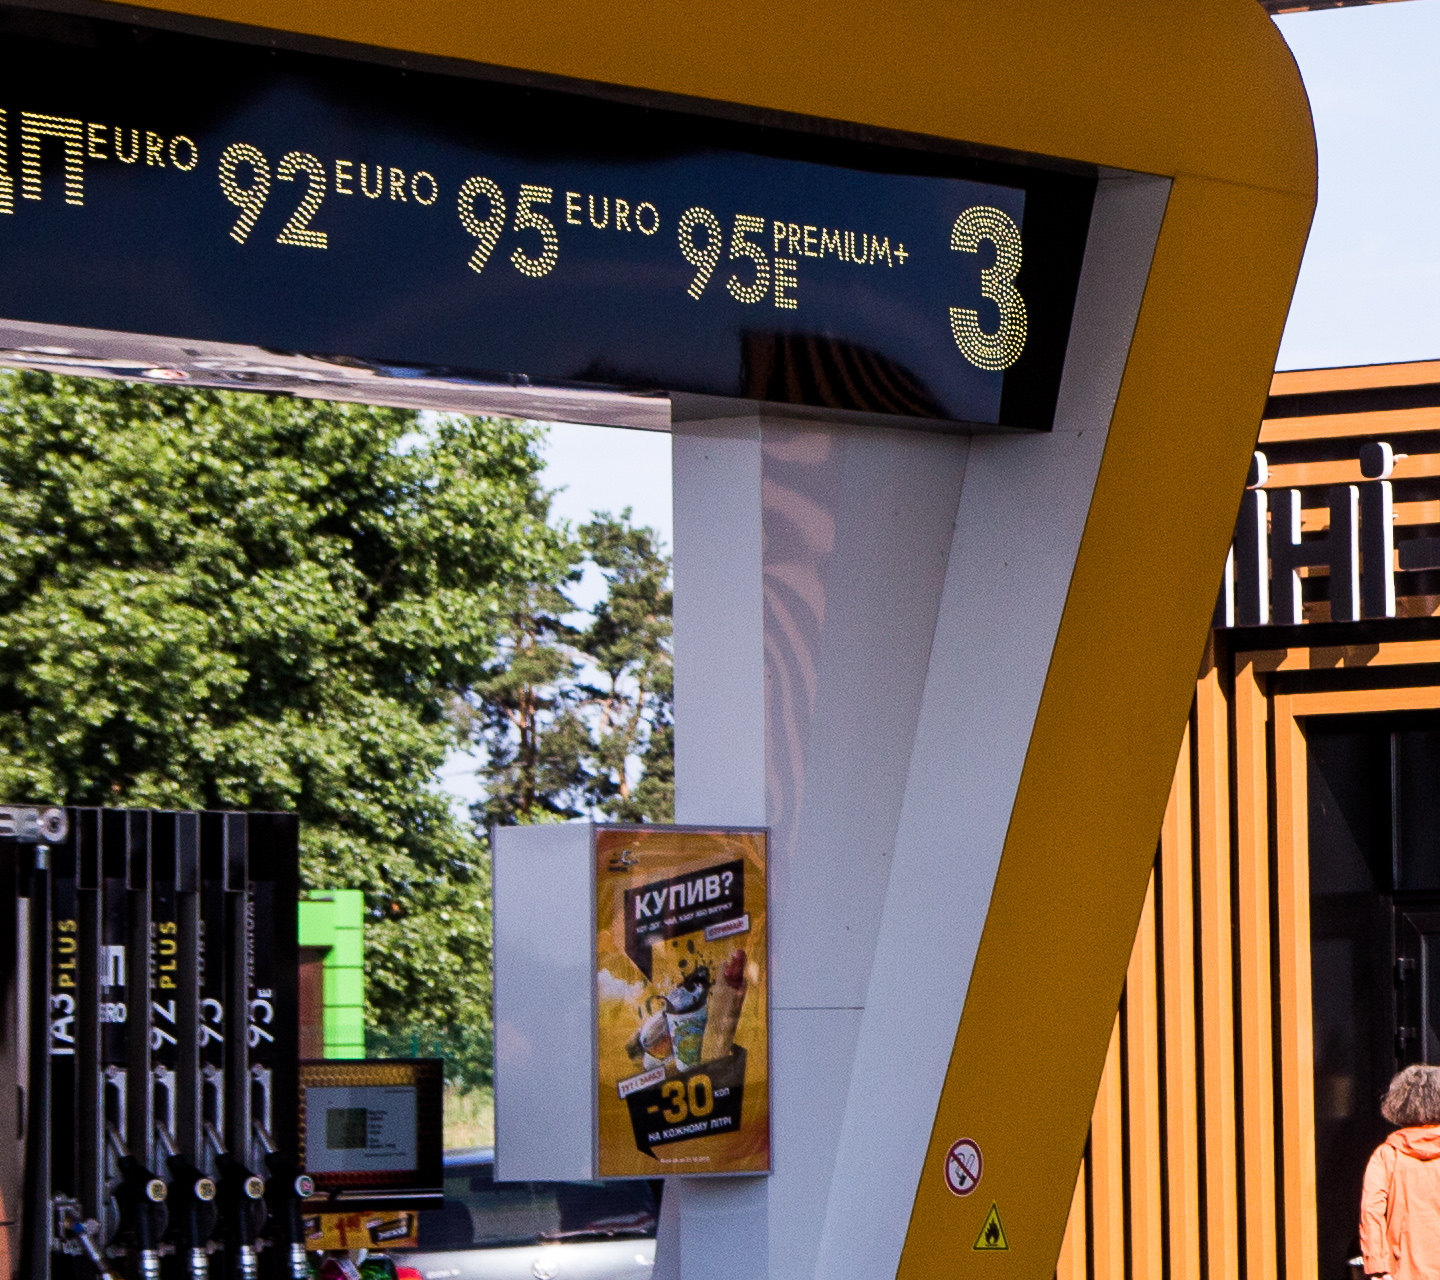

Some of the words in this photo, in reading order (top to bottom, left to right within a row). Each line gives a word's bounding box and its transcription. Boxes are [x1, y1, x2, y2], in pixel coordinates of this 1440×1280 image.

[0, 108, 85, 215] П
[87, 122, 199, 172] EURO
[216, 141, 329, 252] 92
[333, 159, 440, 207] EURO
[455, 174, 559, 279] 95
[564, 190, 662, 236] EURO
[771, 218, 910, 269] PREMIUM+
[947, 204, 1029, 373] 3
[634, 870, 734, 921] КУПИВ?
[58, 919, 77, 989] PLUS
[159, 921, 178, 990] PLUS
[646, 1073, 715, 1124] -30
